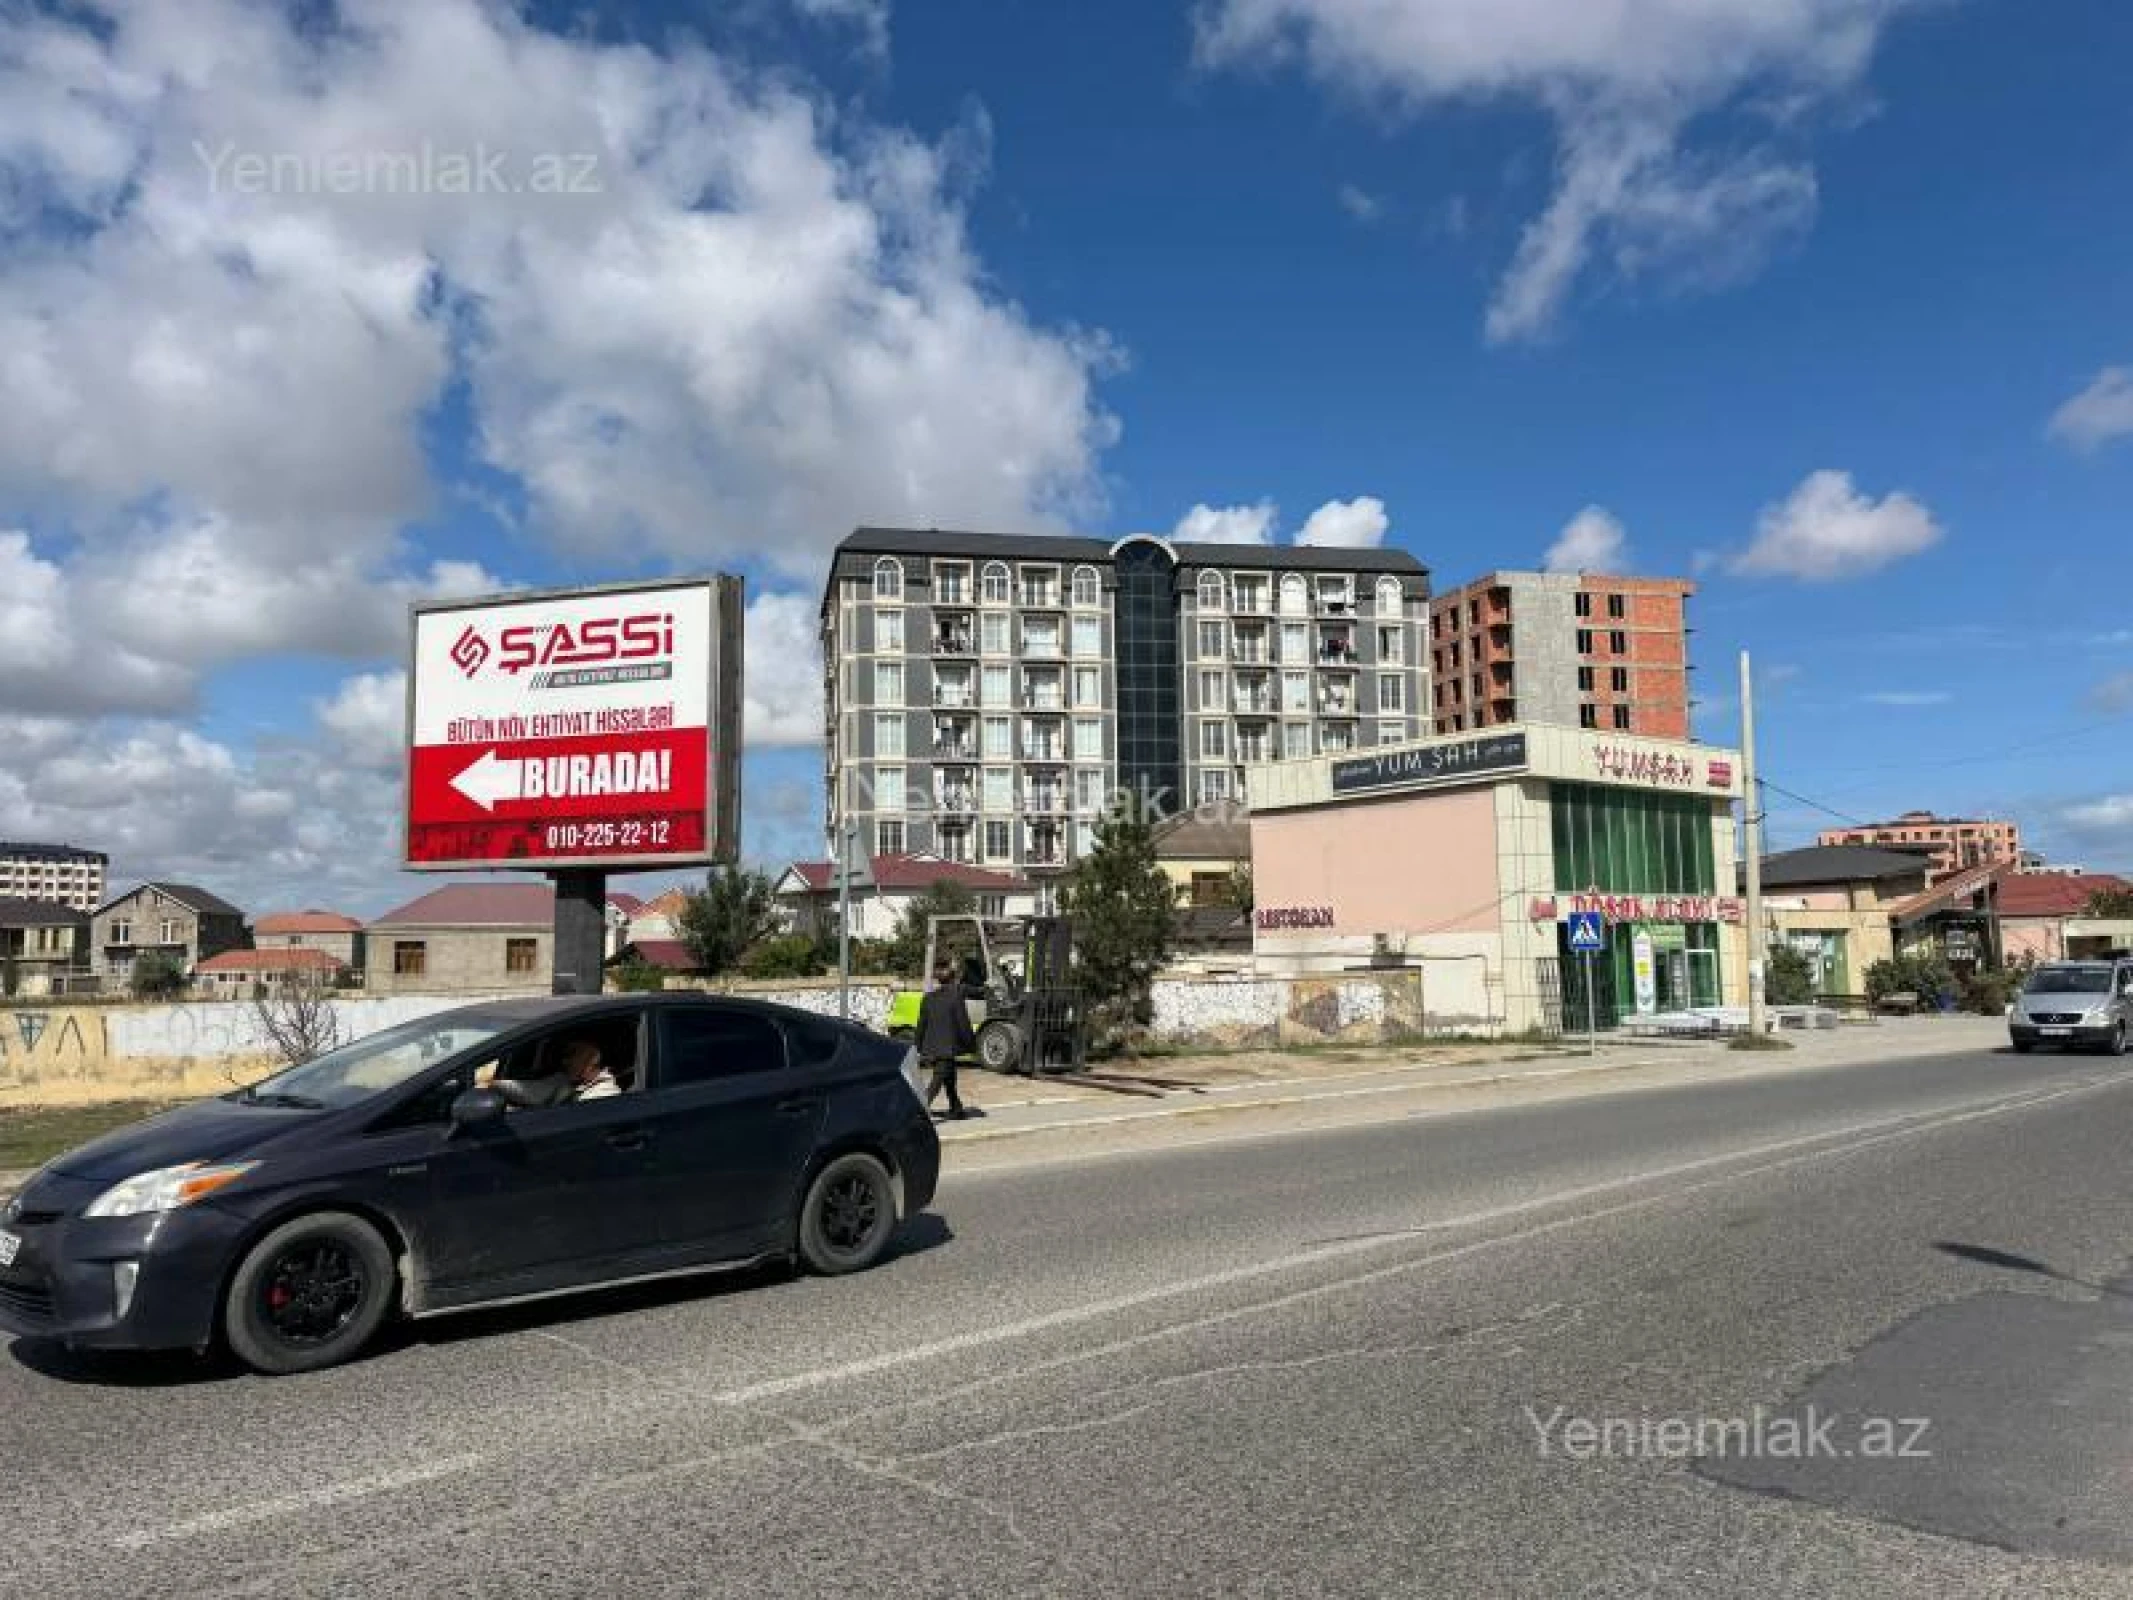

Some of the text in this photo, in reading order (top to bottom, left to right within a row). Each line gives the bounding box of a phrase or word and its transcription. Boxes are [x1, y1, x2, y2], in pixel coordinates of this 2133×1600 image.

[448, 716, 495, 742] BÜTÜN
[499, 712, 529, 740] NÖV
[533, 708, 592, 736] EHTİYAT
[523, 750, 672, 798] BURADA!
[546, 819, 670, 848] 010-225-22-12
